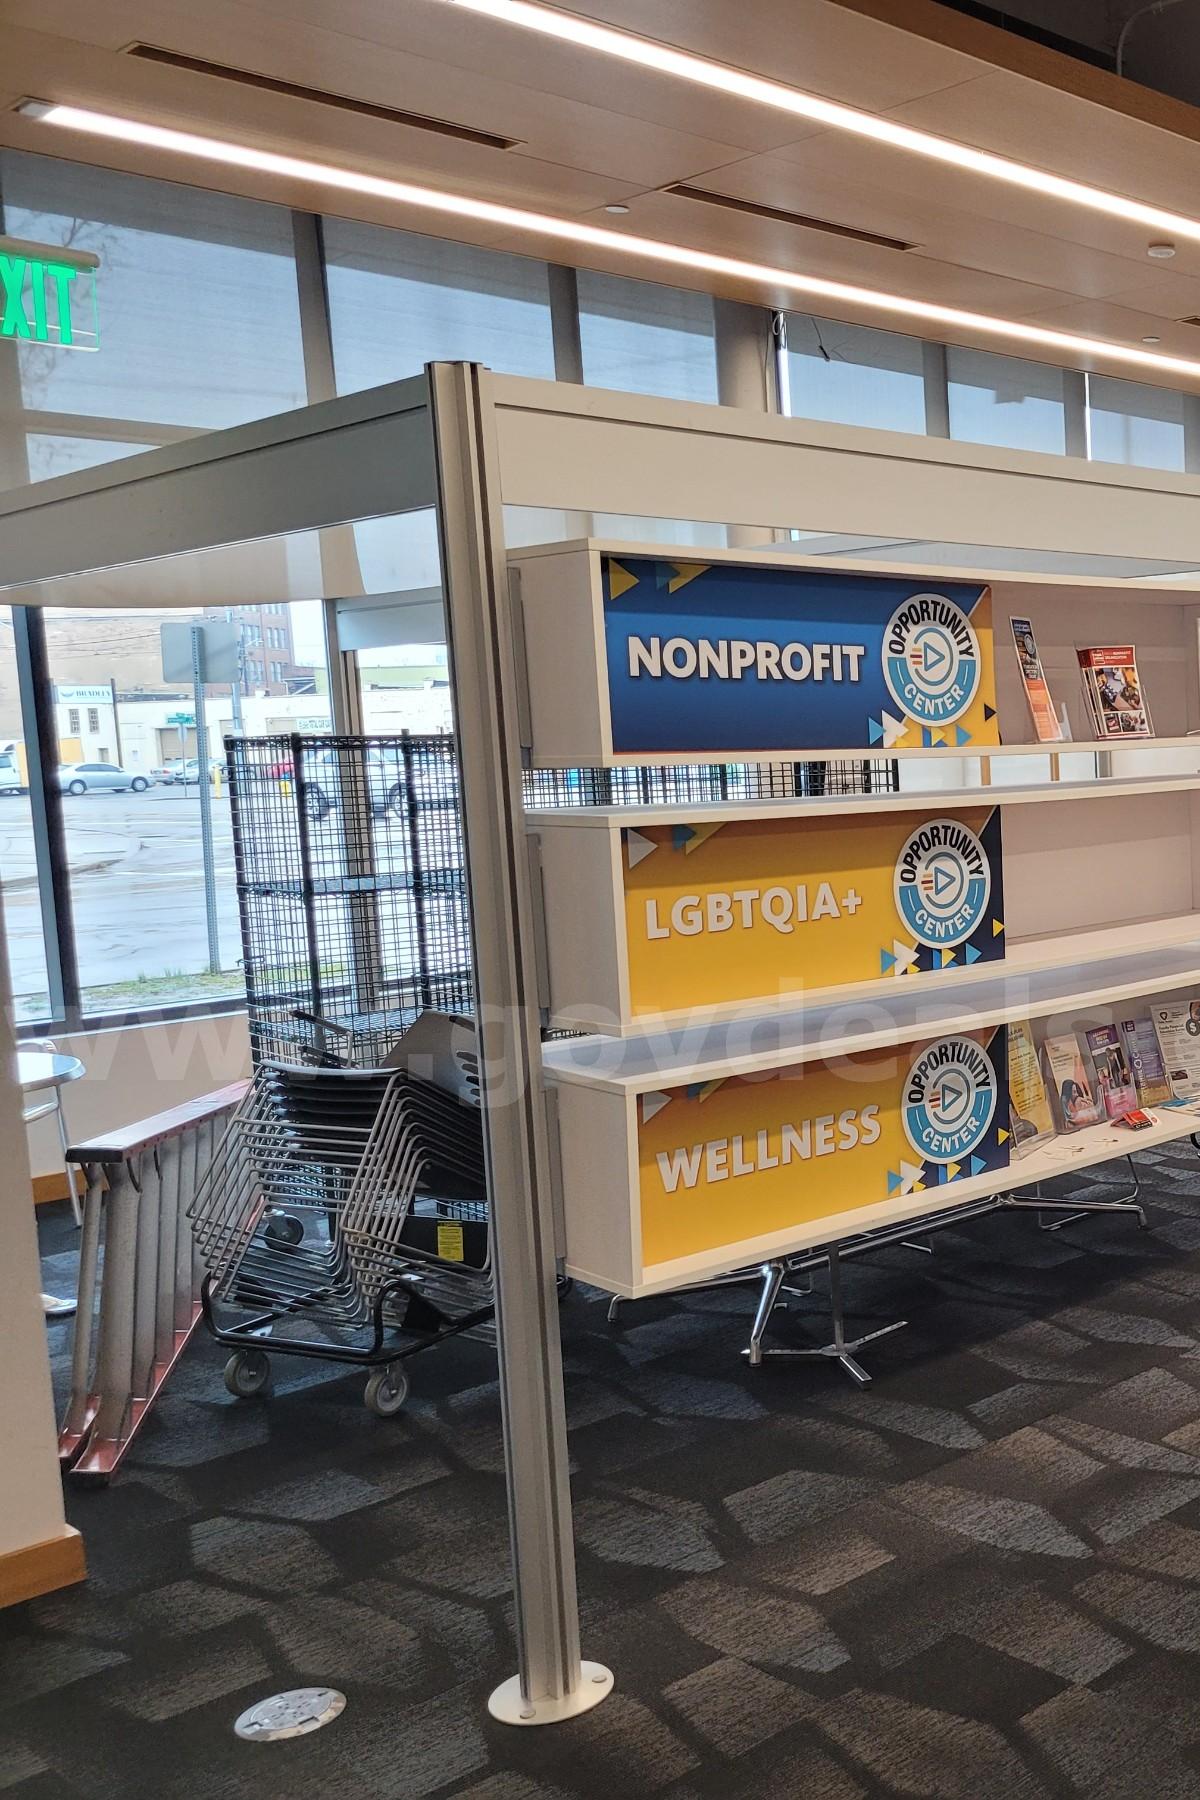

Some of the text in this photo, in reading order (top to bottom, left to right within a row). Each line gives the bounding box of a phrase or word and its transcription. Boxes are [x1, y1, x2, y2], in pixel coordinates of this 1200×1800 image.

[887, 599, 975, 658] OPPORTUNITY
[627, 635, 866, 682] NONPROFIT
[903, 682, 965, 716] CENTER
[899, 824, 985, 883] OPPORTUNITY
[645, 882, 863, 941] LGBTQIA+
[914, 903, 975, 938] CENTER
[907, 1040, 991, 1104] OPPORTUNITY
[655, 1104, 882, 1193] WELLNESS
[921, 1116, 981, 1154] CENTER
